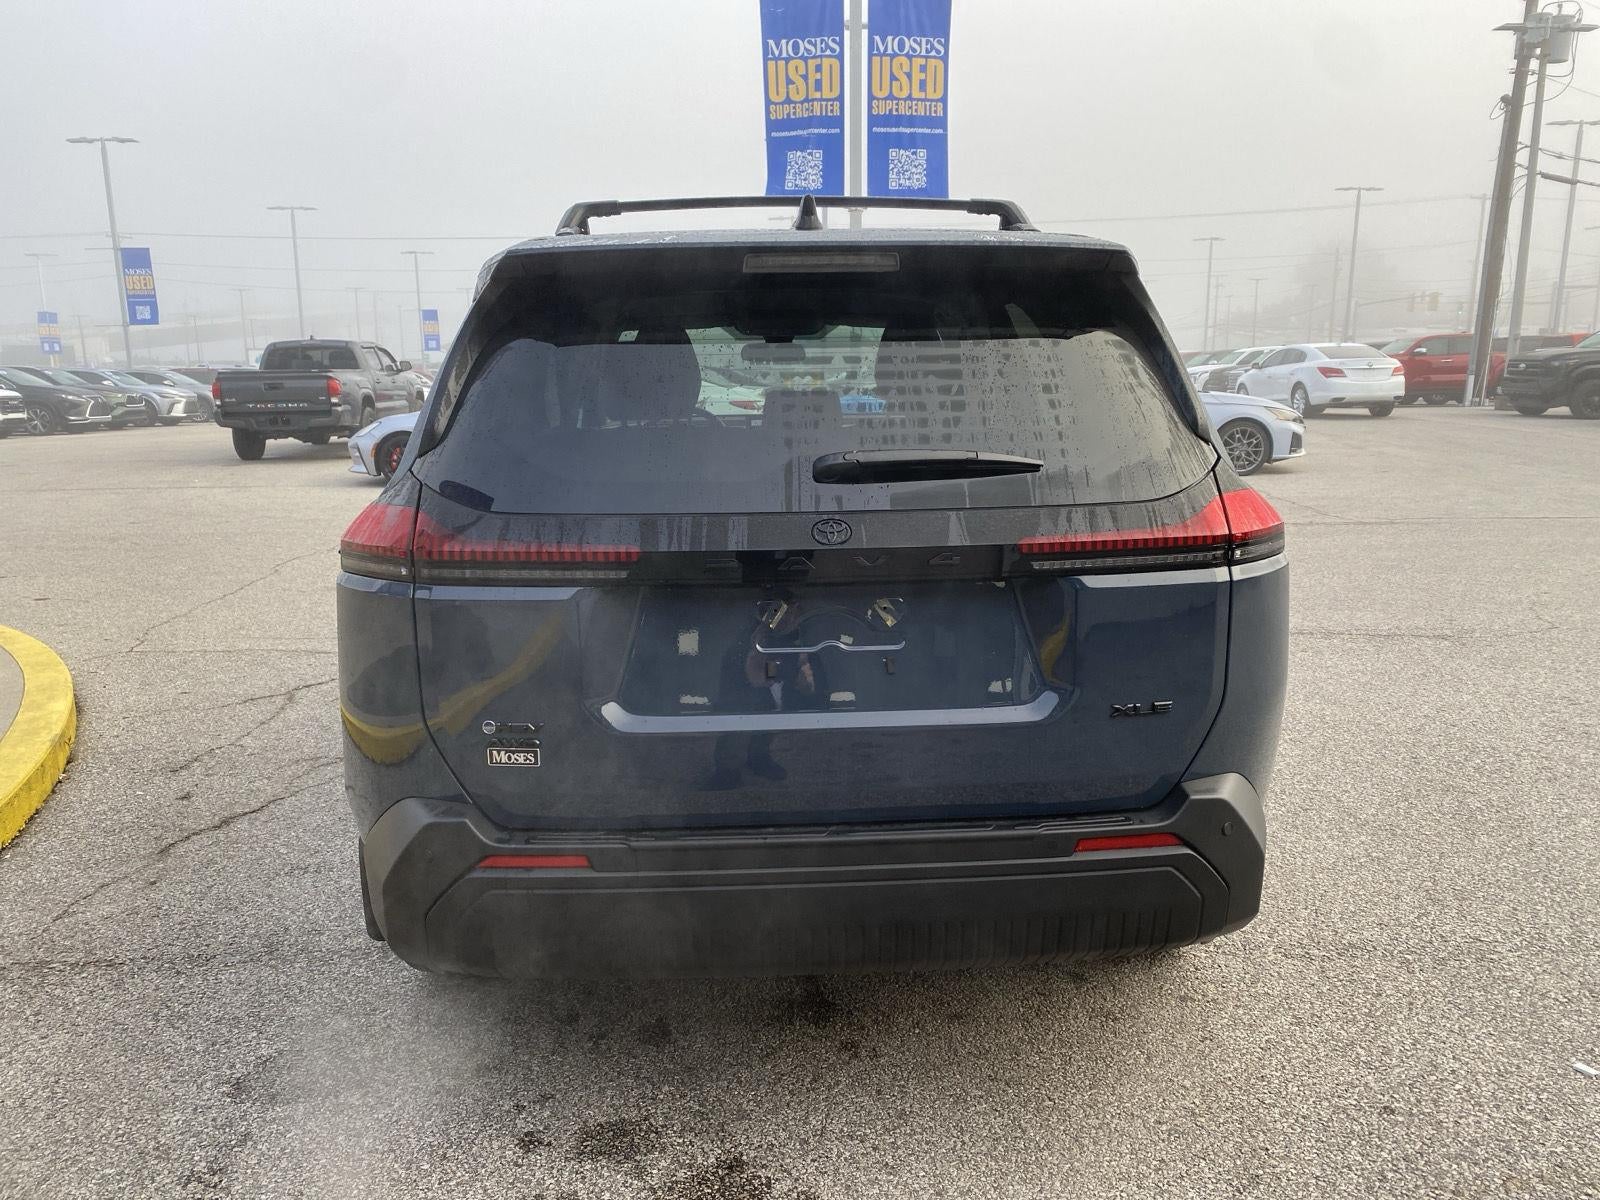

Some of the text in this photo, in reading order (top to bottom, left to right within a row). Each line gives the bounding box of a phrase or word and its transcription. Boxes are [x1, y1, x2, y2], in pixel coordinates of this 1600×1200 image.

[767, 36, 840, 58] MOSES
[873, 35, 945, 56] MOSES
[767, 58, 840, 102] USED
[871, 56, 945, 99] USED
[769, 101, 840, 120] SUPERCENTER
[872, 99, 944, 117] SUPERCENTER
[124, 267, 152, 276] MOSES
[125, 275, 154, 290] USED
[1110, 700, 1173, 718] XLE
